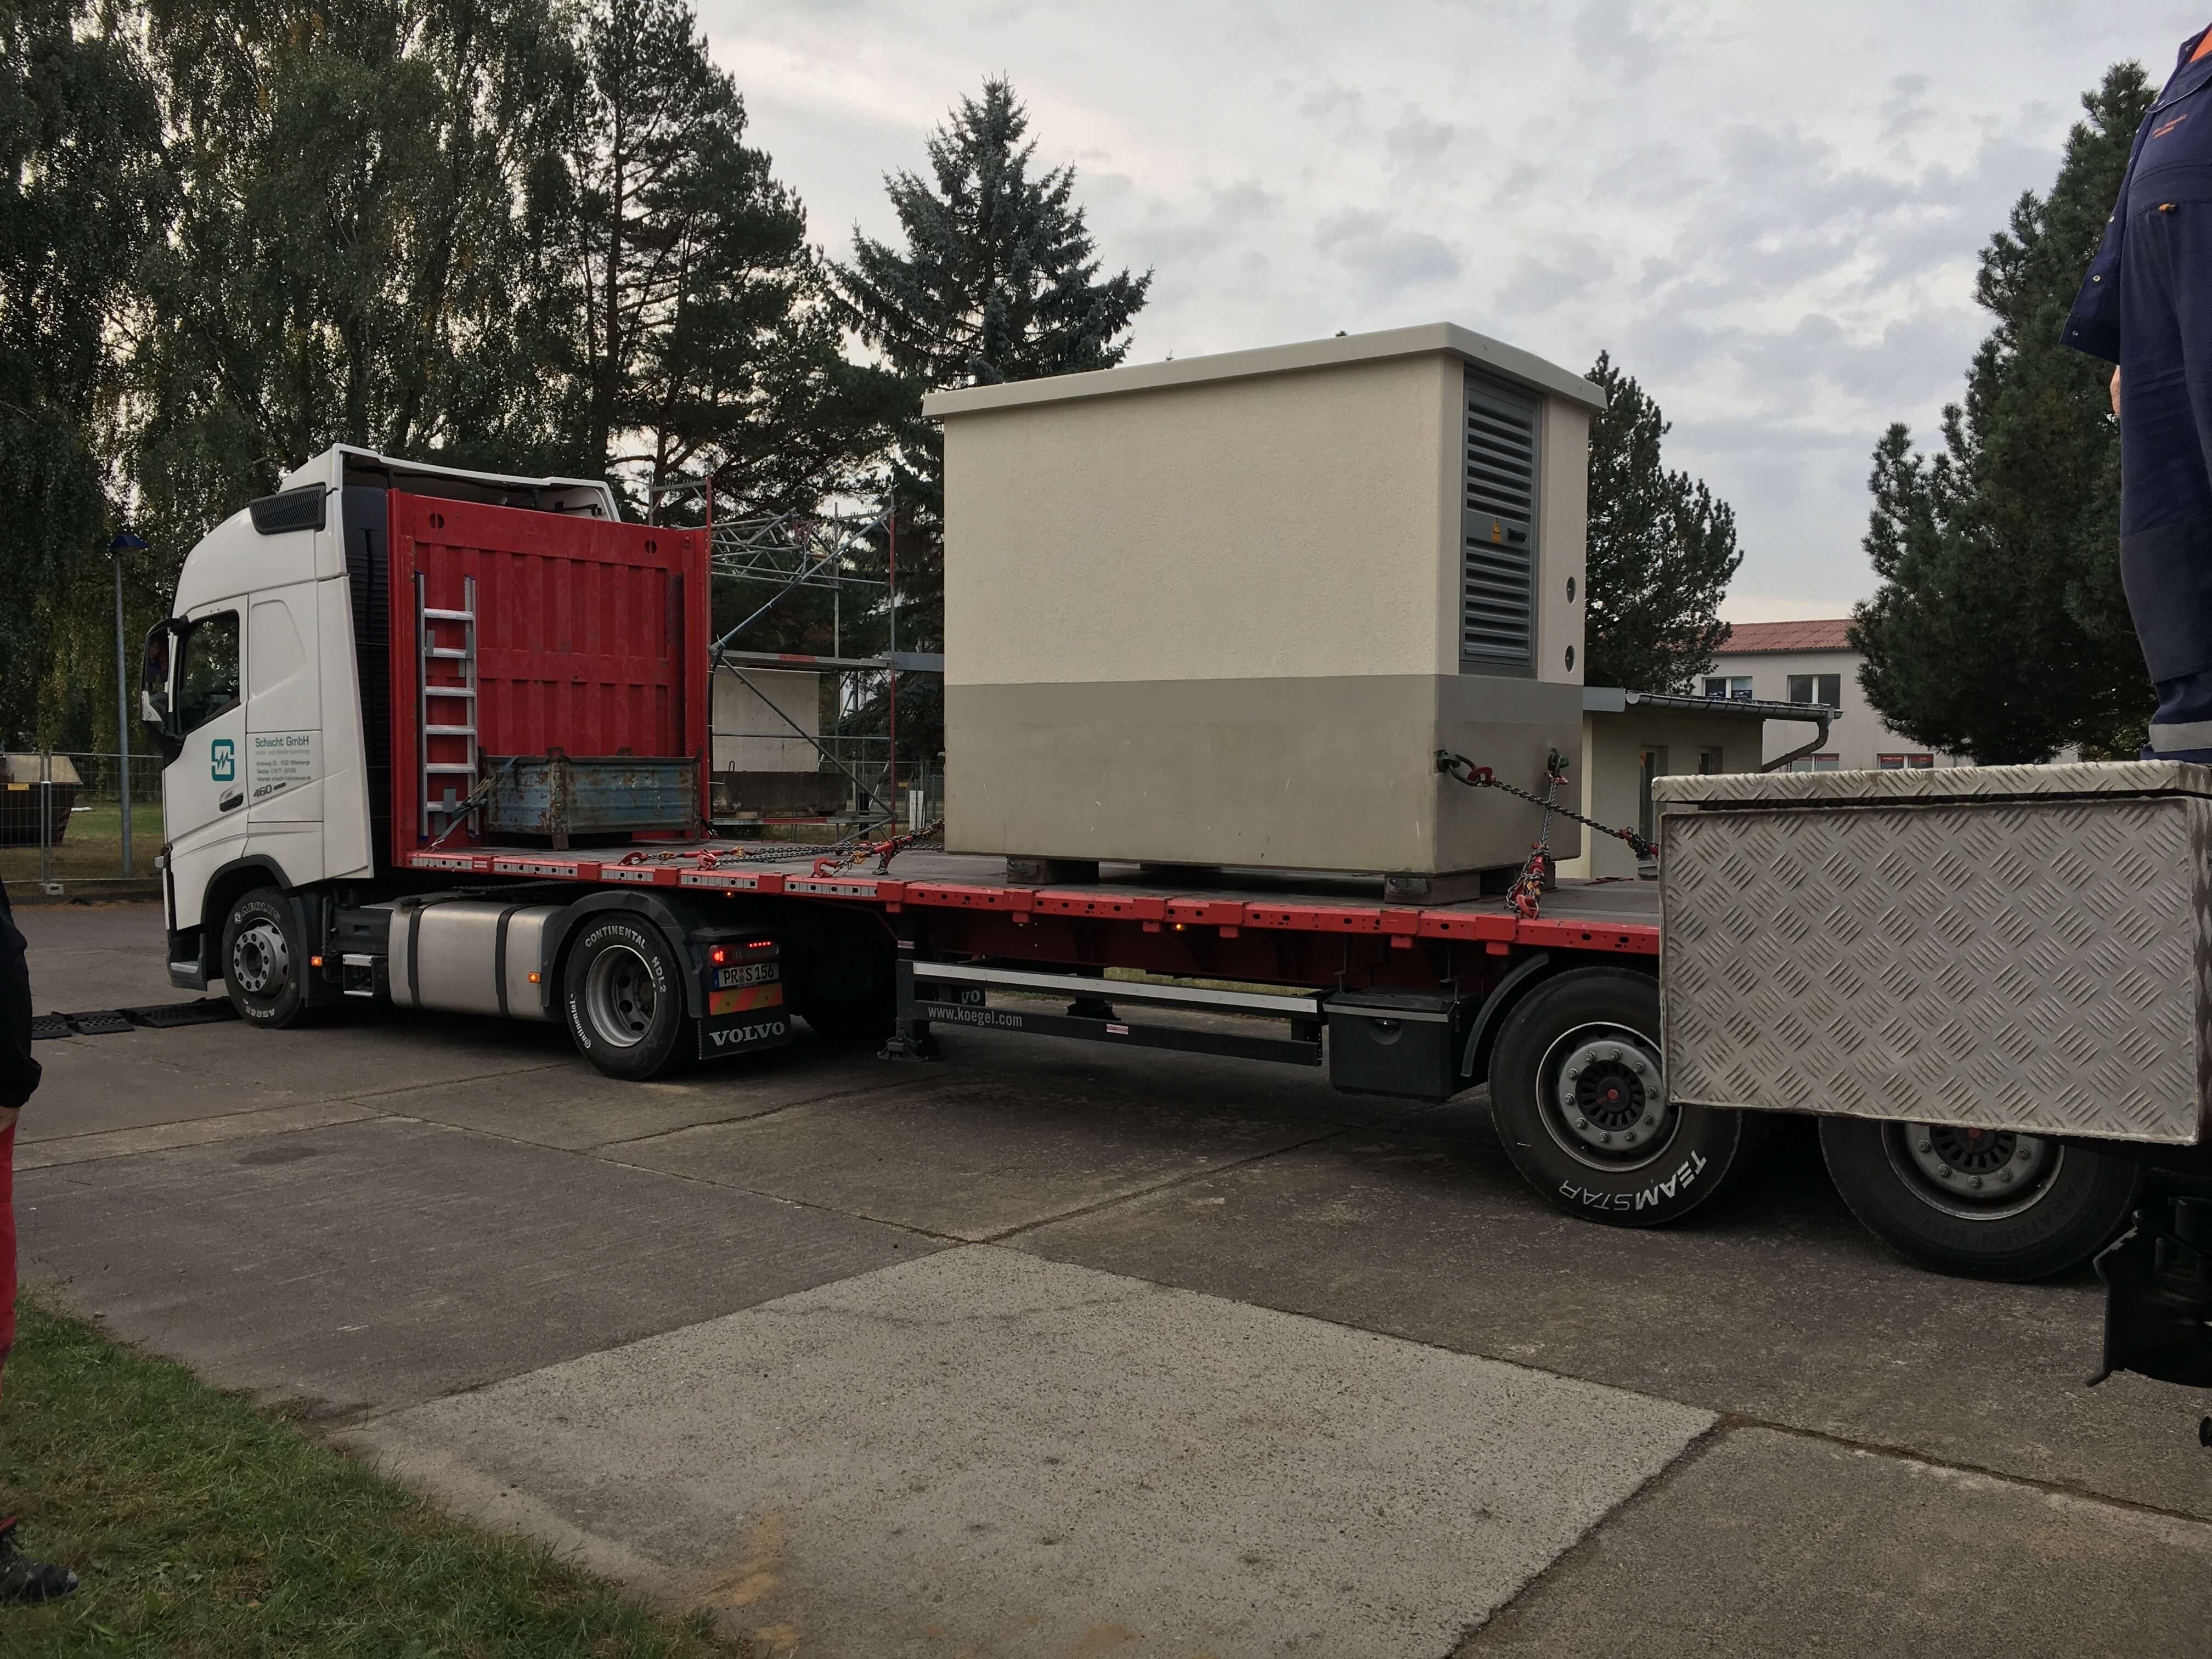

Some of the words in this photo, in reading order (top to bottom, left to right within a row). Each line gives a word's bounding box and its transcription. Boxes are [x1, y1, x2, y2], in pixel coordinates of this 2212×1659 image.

[255, 737, 284, 747] Schacht
[286, 736, 309, 746] GmbH
[585, 925, 646, 949] CONTINENTAL
[724, 969, 738, 985] PR
[746, 967, 753, 981] S
[755, 964, 774, 981] 156
[927, 1006, 1023, 1028] www.koegel.com
[709, 1021, 786, 1046] VOLVO
[1558, 1149, 1707, 1211] TEAMSTAR
